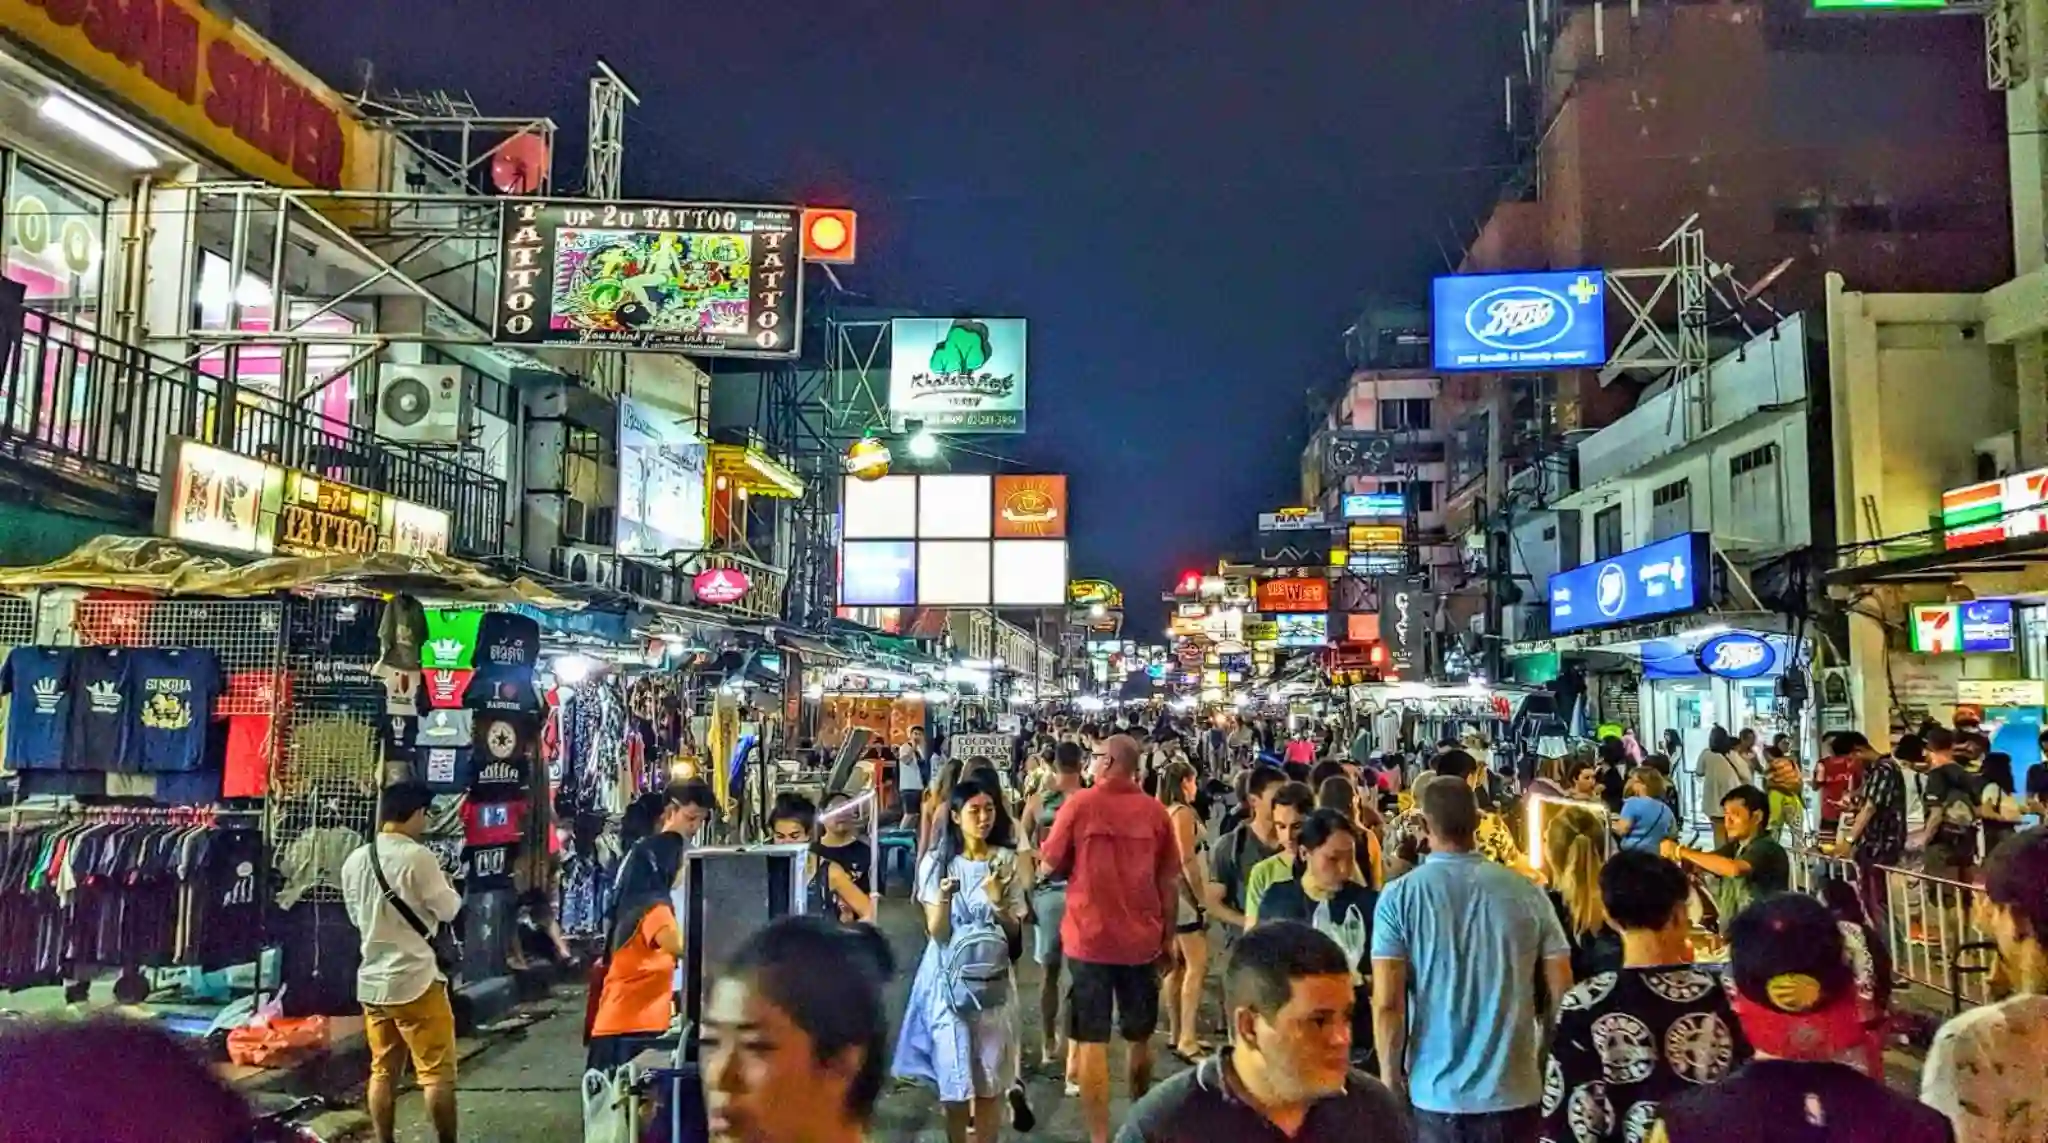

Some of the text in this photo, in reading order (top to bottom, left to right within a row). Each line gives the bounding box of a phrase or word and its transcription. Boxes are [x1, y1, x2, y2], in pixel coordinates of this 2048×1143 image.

[564, 208, 596, 227] UP
[642, 206, 738, 231] TATTOO
[504, 201, 547, 335] TATTOO
[756, 231, 788, 348] TATTOO
[283, 505, 377, 553] TATTOO
